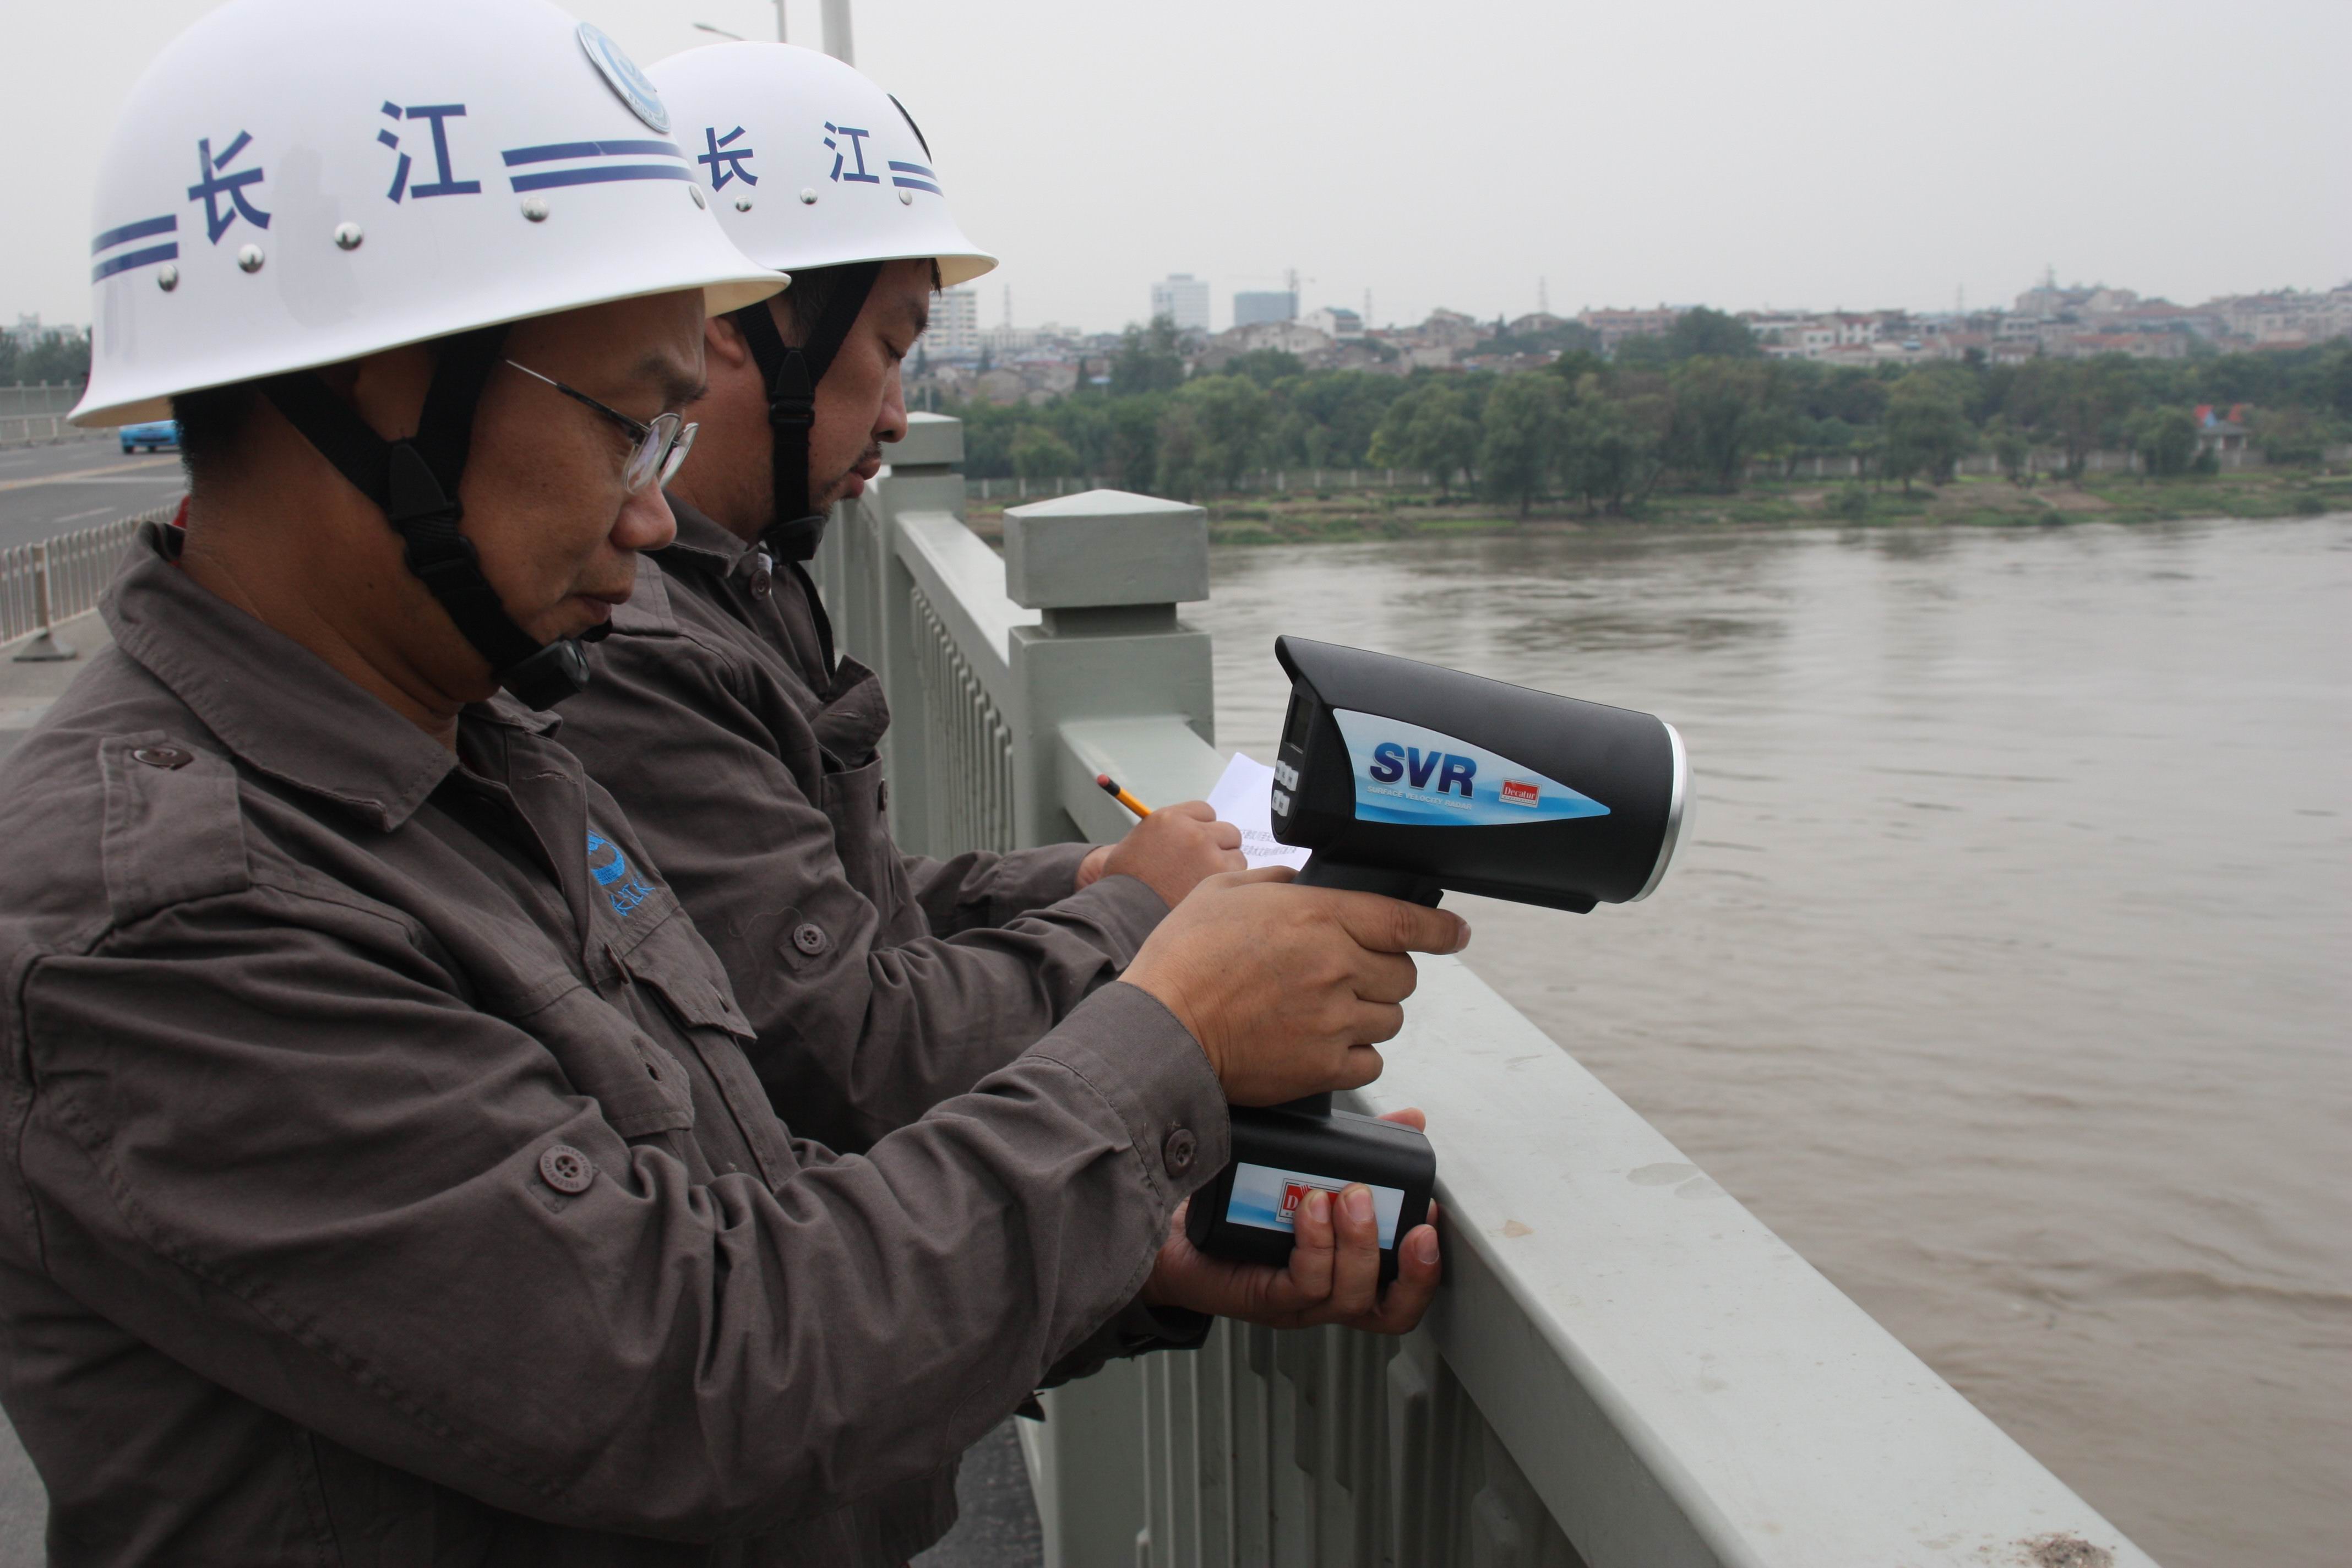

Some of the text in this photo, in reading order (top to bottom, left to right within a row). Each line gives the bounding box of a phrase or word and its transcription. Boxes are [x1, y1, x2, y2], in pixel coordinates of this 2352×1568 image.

[188, 100, 481, 246] 长江
[698, 121, 880, 193] 长江
[1366, 785, 1473, 811] SURFACE VELOCITY RADAR
[1369, 742, 1477, 798] SVR
[1504, 786, 1536, 799] Decatur
